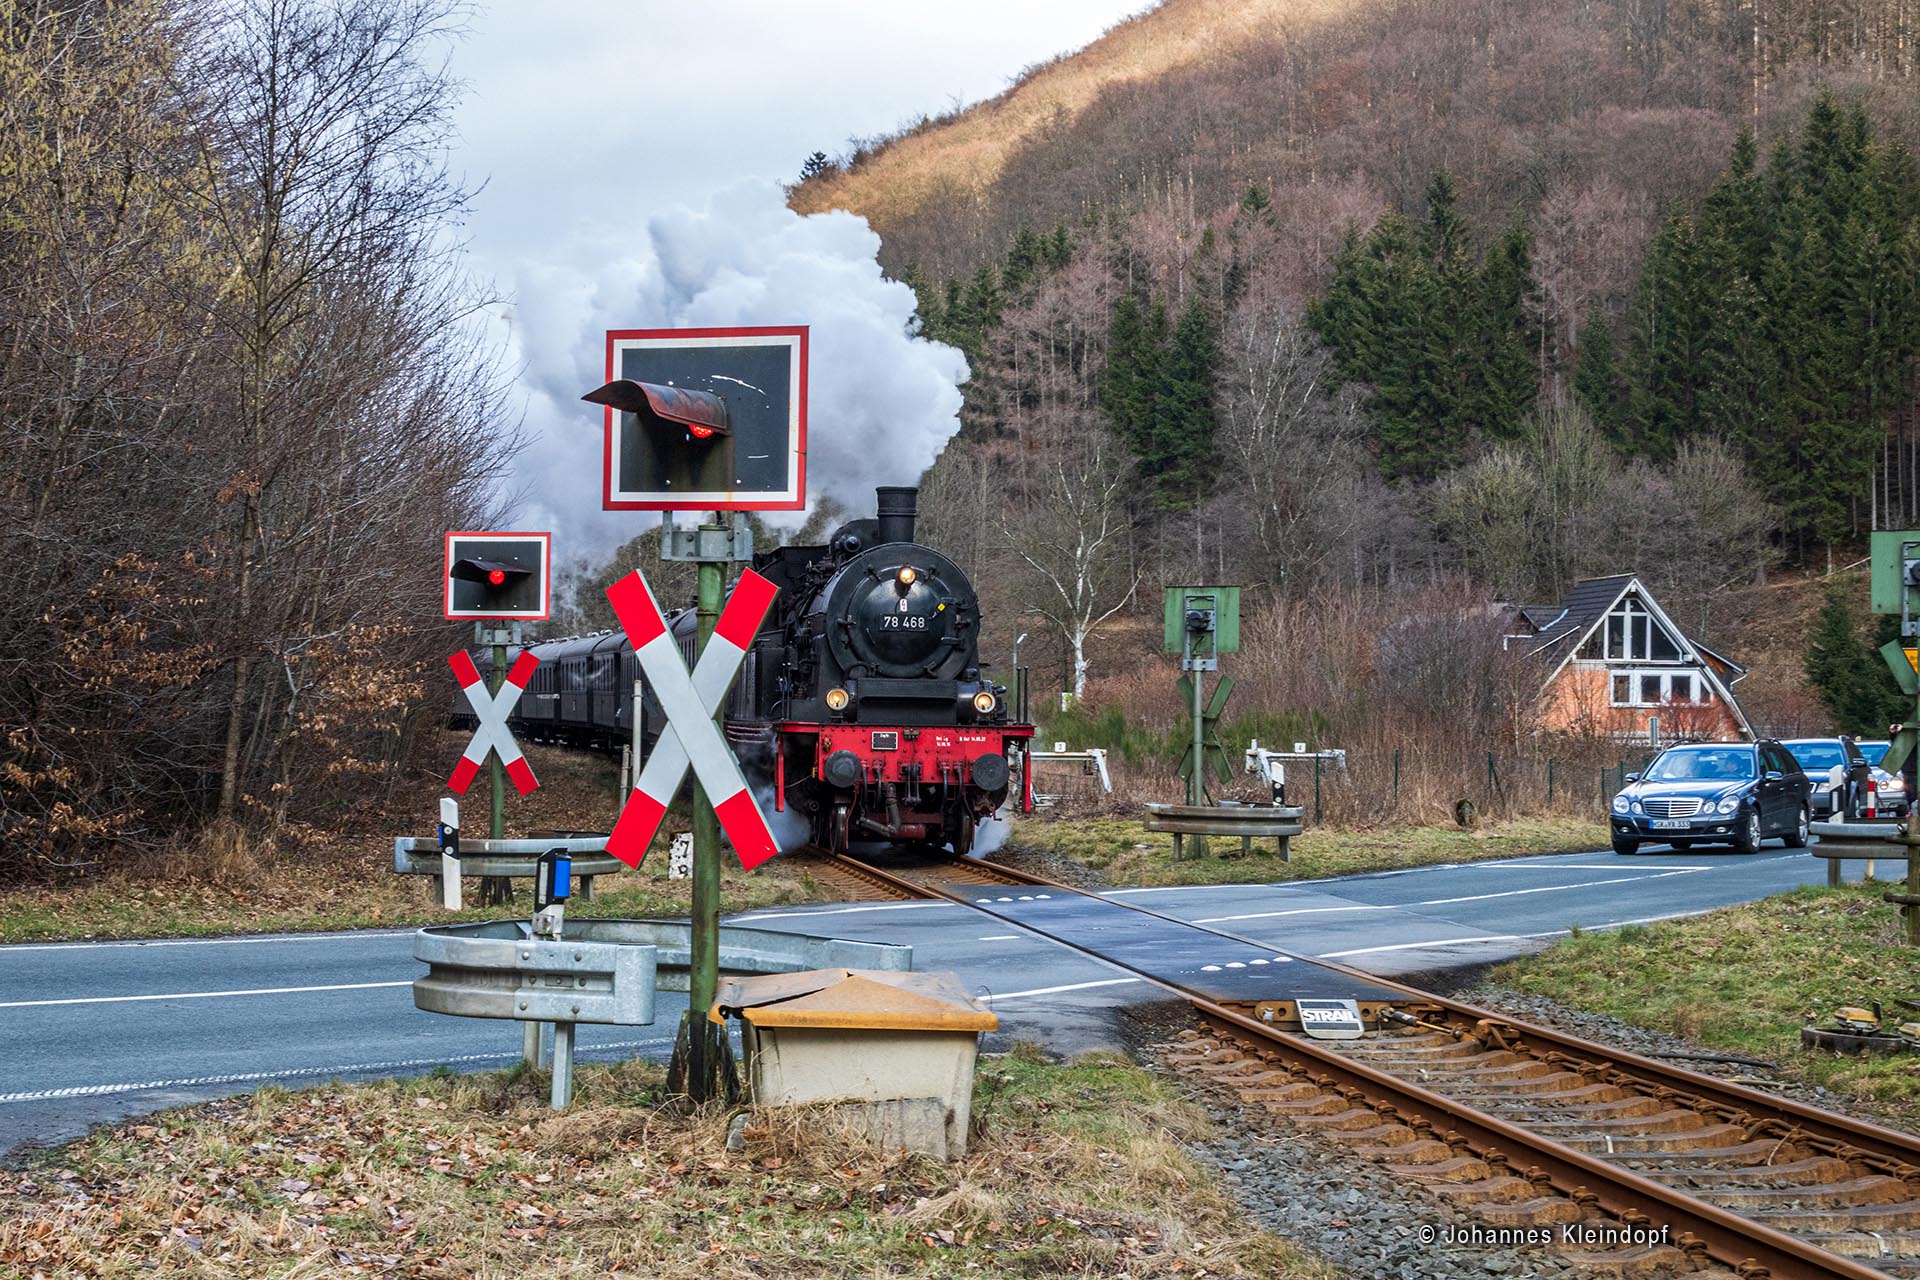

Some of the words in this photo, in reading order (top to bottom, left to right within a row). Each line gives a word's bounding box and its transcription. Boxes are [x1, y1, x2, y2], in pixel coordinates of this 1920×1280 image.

[883, 616, 899, 628] 78
[902, 616, 925, 628] 468
[1302, 1008, 1359, 1023] STRAIL
